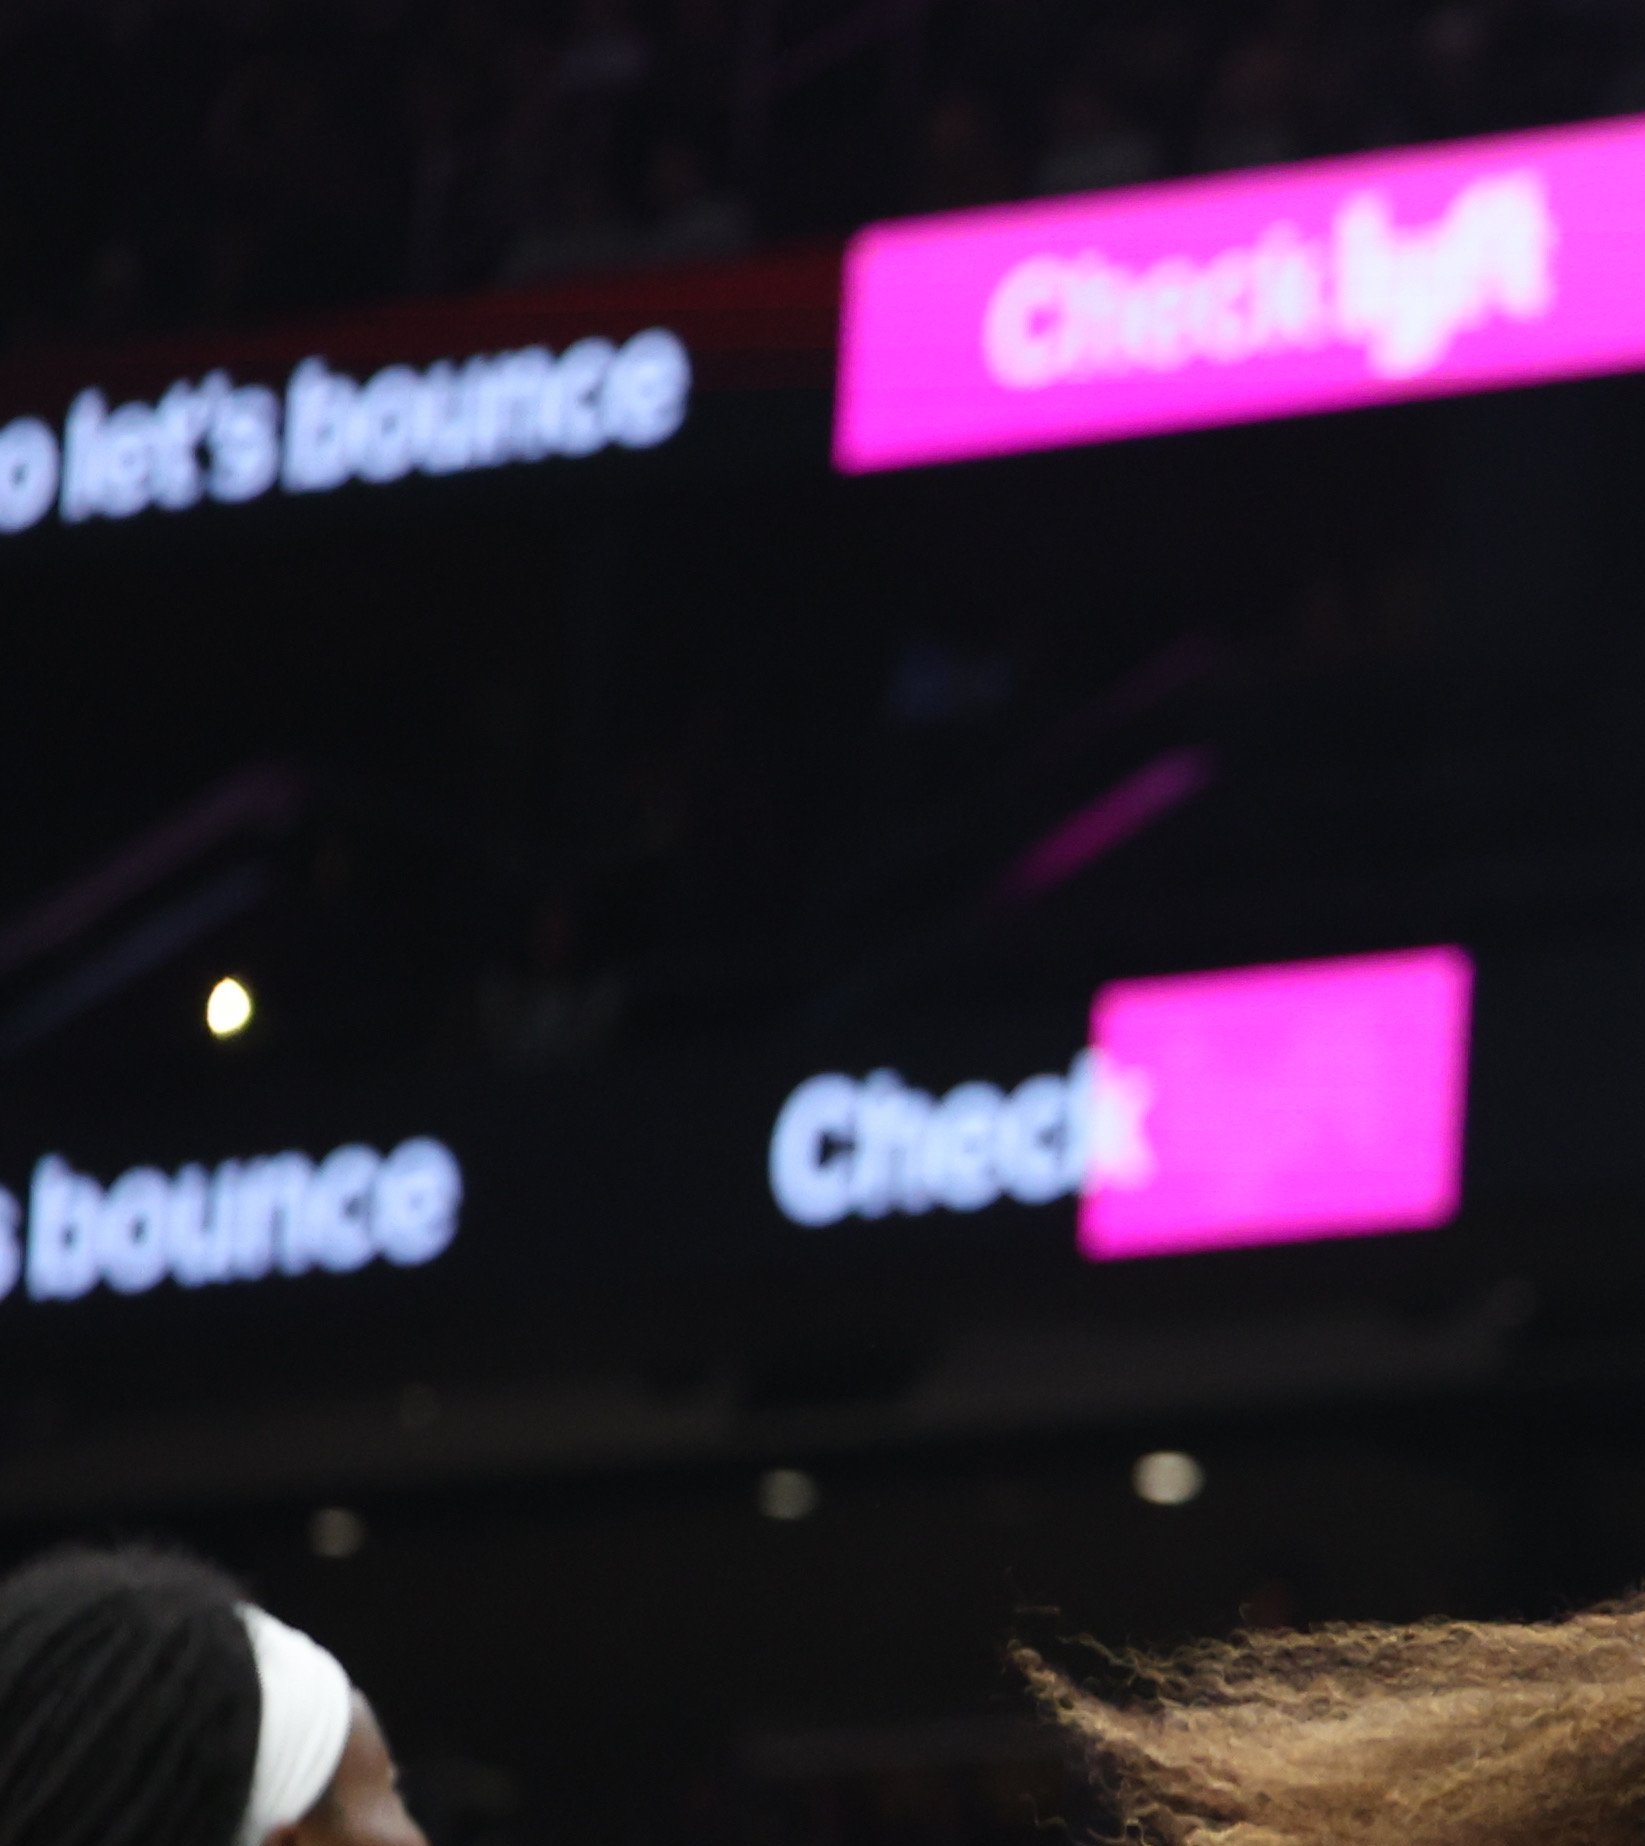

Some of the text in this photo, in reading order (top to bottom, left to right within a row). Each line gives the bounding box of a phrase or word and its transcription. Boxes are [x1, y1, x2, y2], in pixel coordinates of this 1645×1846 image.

[981, 223, 1325, 391] Check
[60, 371, 282, 523] let's
[283, 330, 691, 493] bounce
[26, 1137, 461, 1302] bounce
[769, 1046, 1158, 1225] Check
